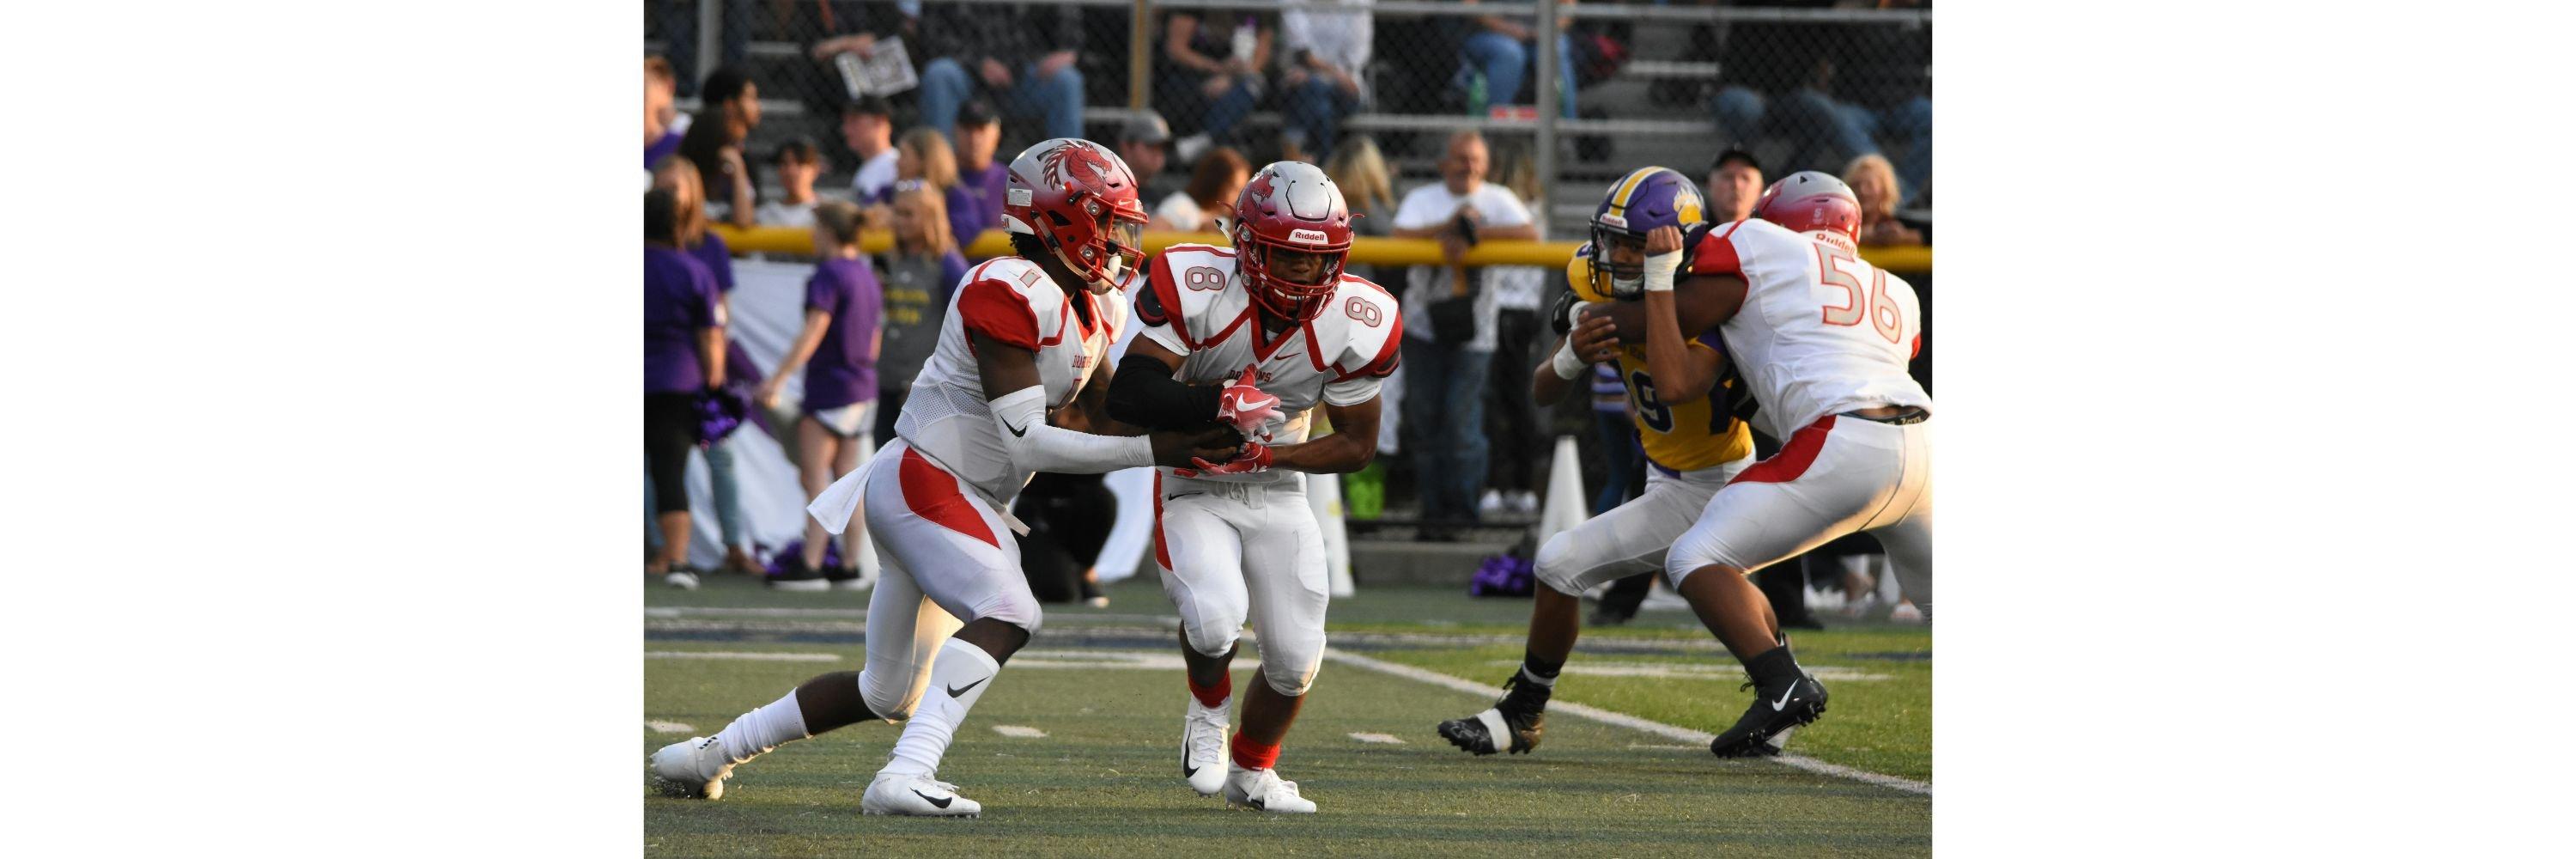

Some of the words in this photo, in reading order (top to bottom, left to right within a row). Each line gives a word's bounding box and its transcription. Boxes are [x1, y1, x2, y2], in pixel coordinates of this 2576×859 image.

[1295, 231, 1324, 241] Riddell
[1185, 265, 1226, 291] 8
[1813, 241, 1903, 344] 56
[1345, 296, 1382, 328] 8
